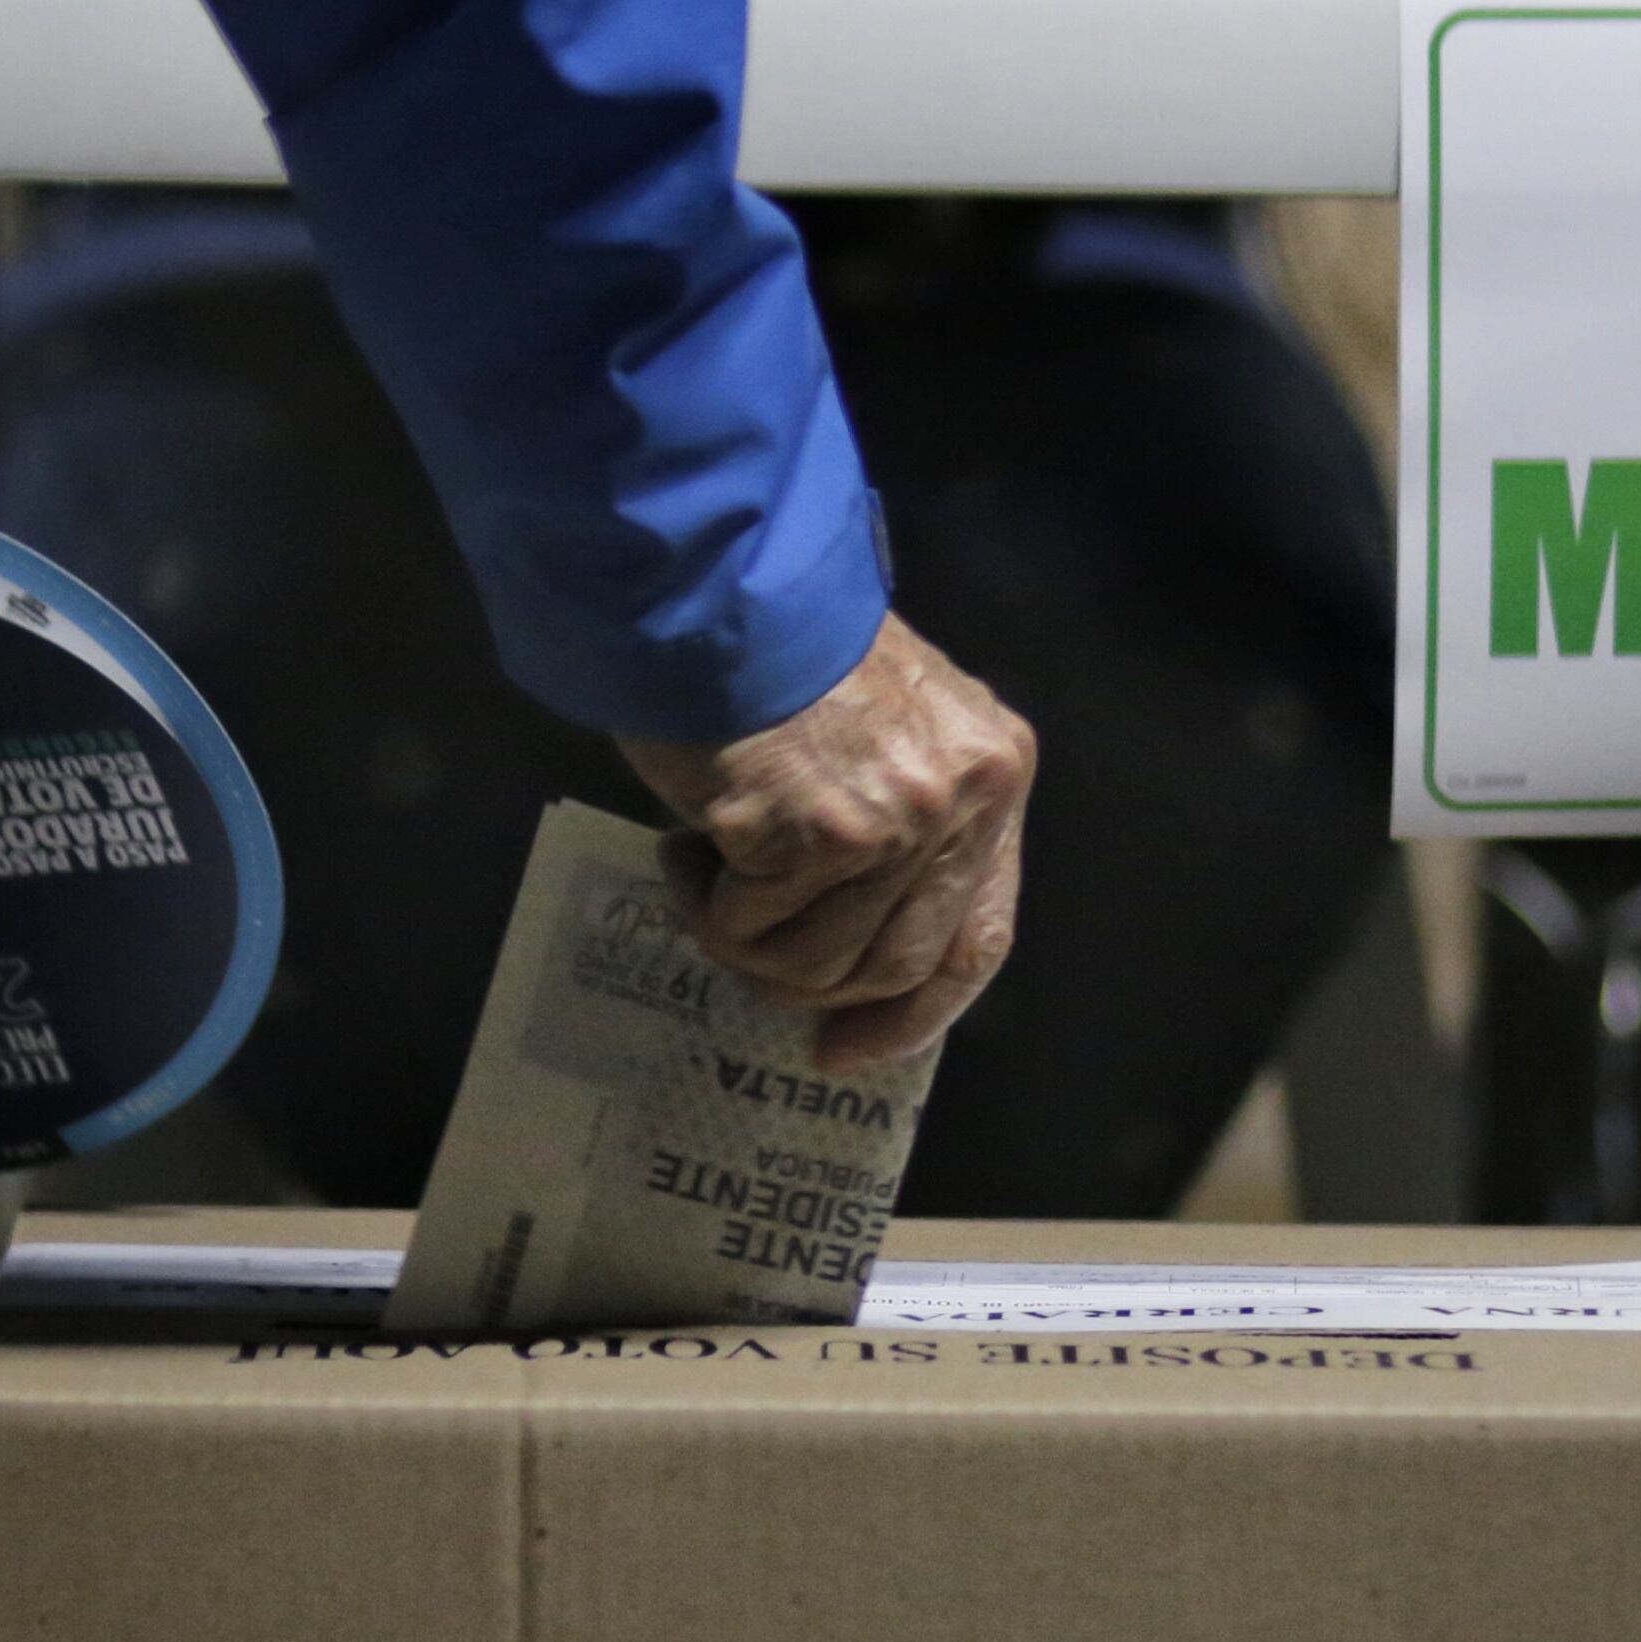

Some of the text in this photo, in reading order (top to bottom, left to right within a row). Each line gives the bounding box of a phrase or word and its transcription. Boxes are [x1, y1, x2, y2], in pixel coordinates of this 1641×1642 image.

[101, 771, 167, 810] DE
[75, 842, 101, 872] A
[103, 838, 192, 869] PASO
[715, 1053, 894, 1132] VUELTA
[512, 1336, 779, 1361] VOTO
[818, 1338, 939, 1365] SU
[977, 1341, 1483, 1372] DEPOSITE
